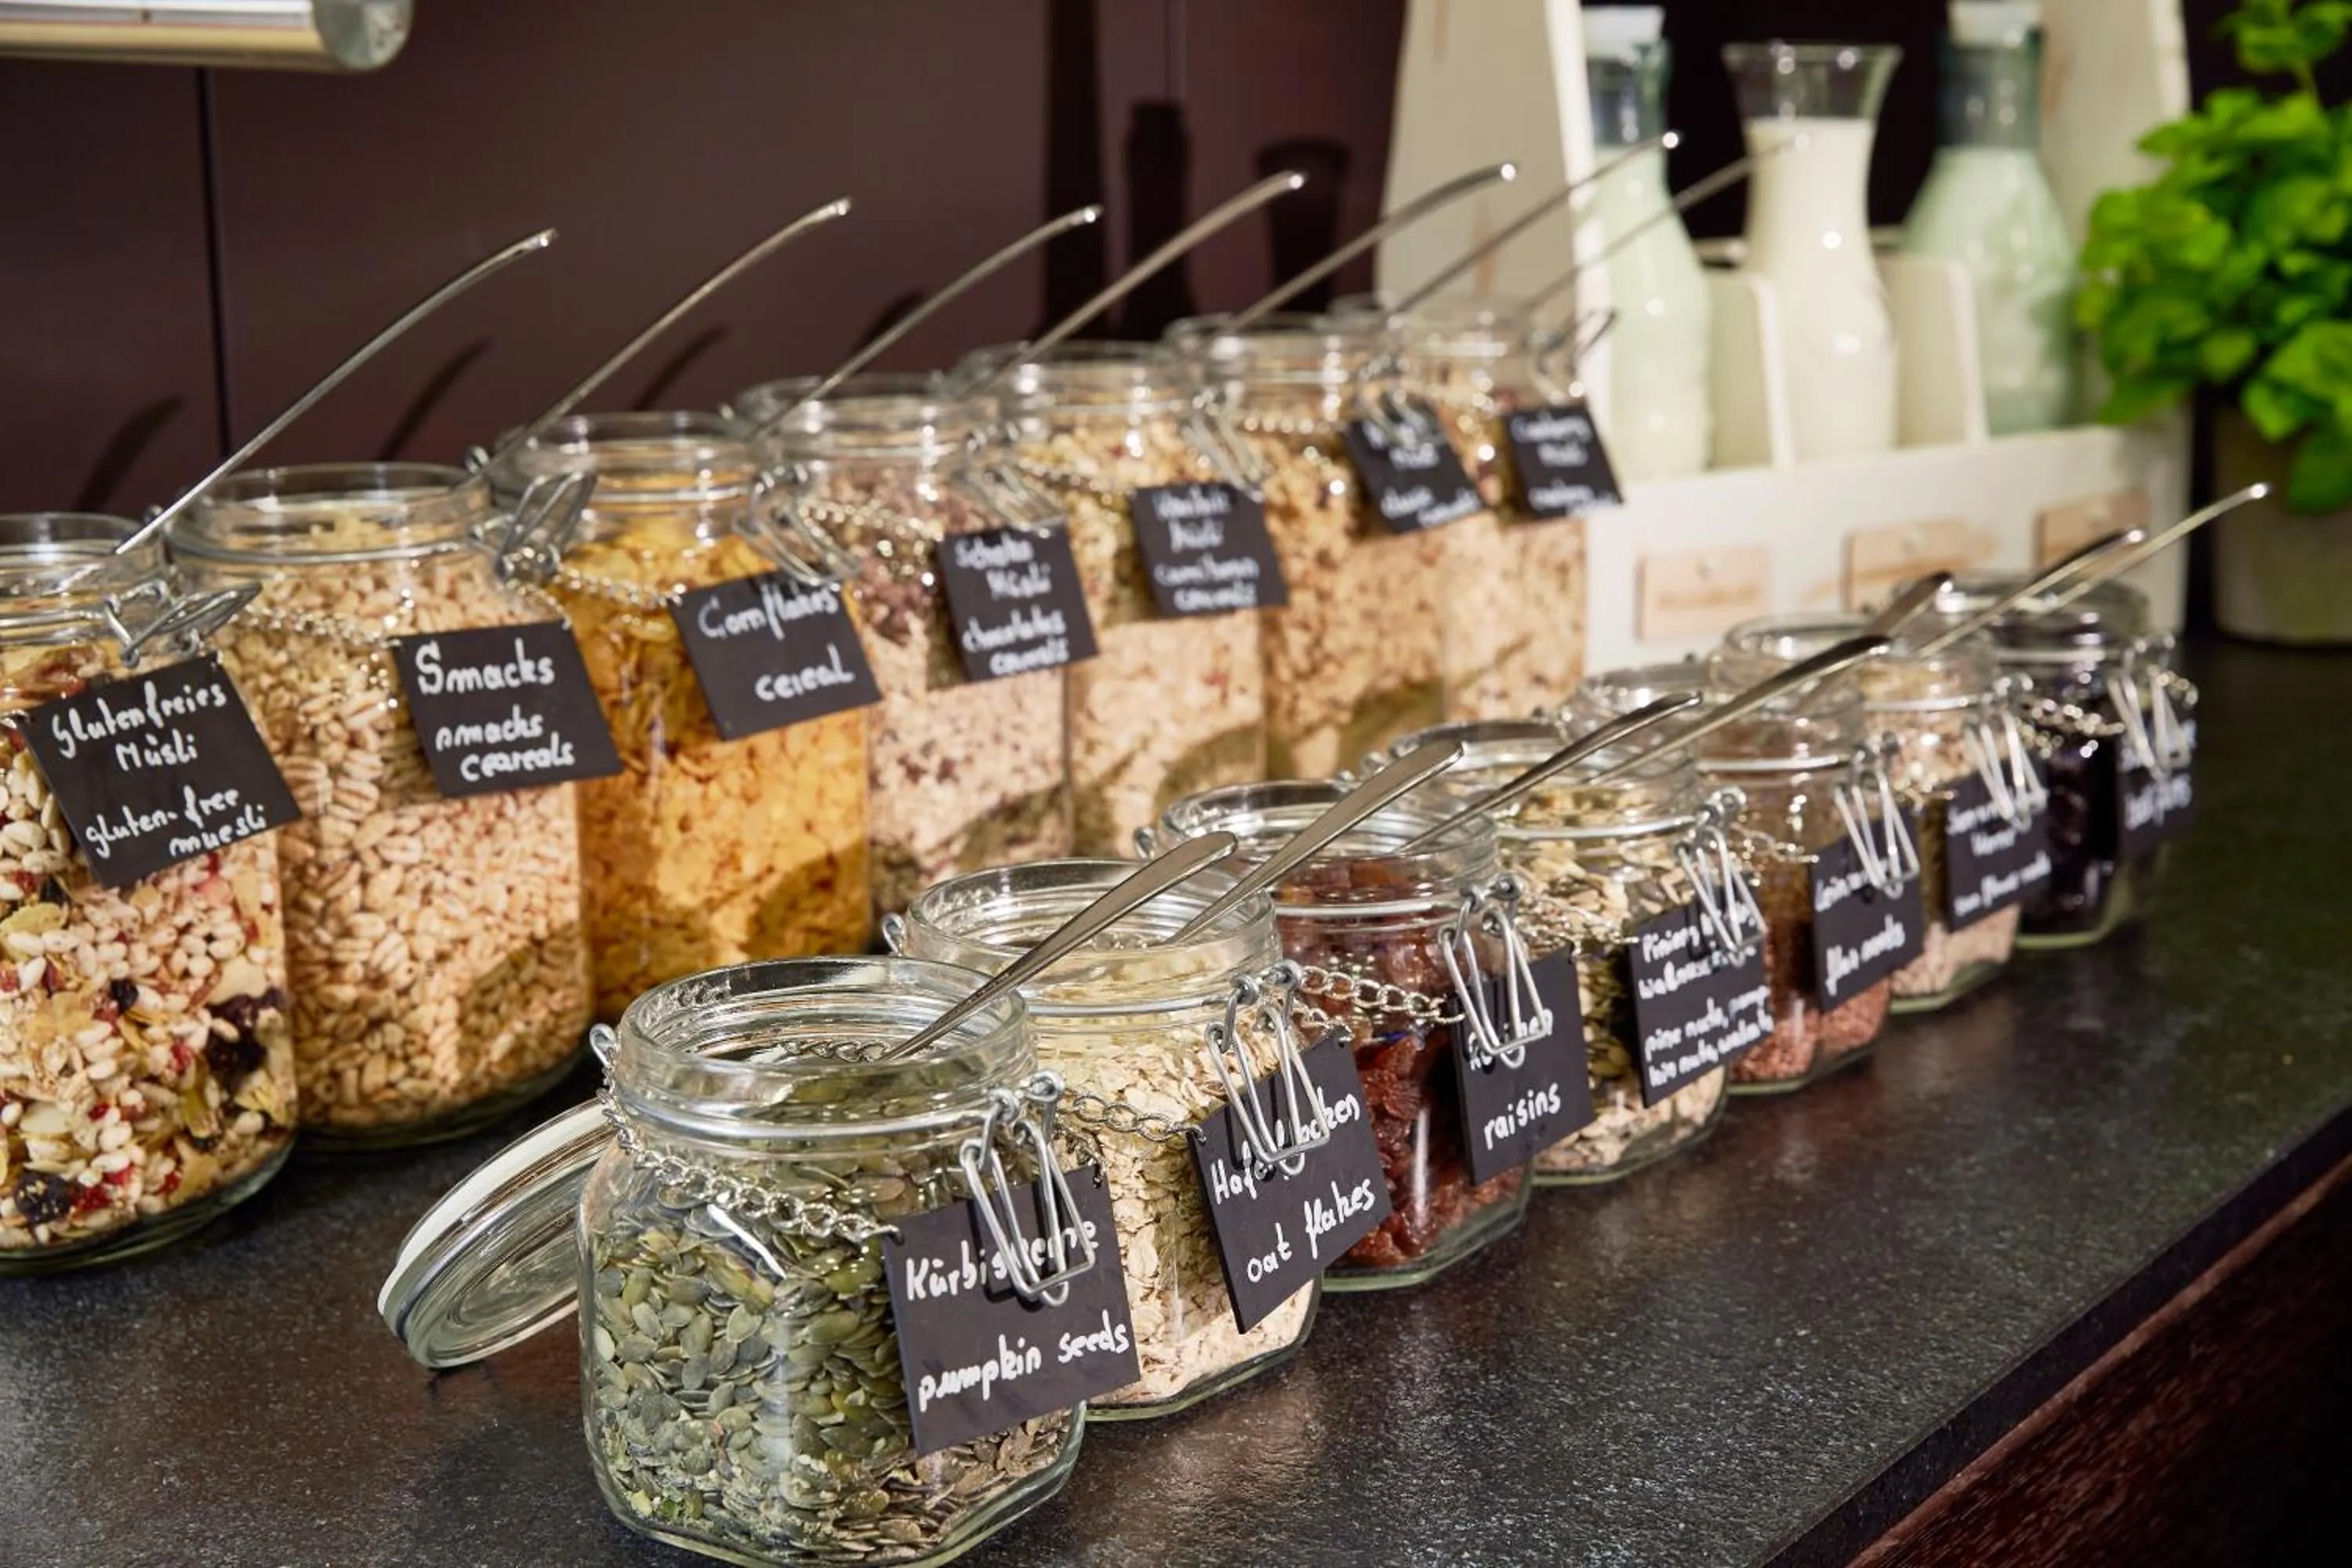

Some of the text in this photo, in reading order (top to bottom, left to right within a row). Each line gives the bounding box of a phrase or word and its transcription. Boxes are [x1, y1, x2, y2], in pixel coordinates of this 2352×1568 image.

[415, 637, 555, 695] Smacks
[754, 643, 855, 702] cereal
[52, 680, 227, 759] Glutenfreies
[114, 728, 198, 771] Müsli
[169, 804, 267, 856] muesli
[1483, 1082, 1561, 1150] raisins
[1247, 1178, 1375, 1283] oat flakes
[918, 1309, 1130, 1413] pumpkin seeds
